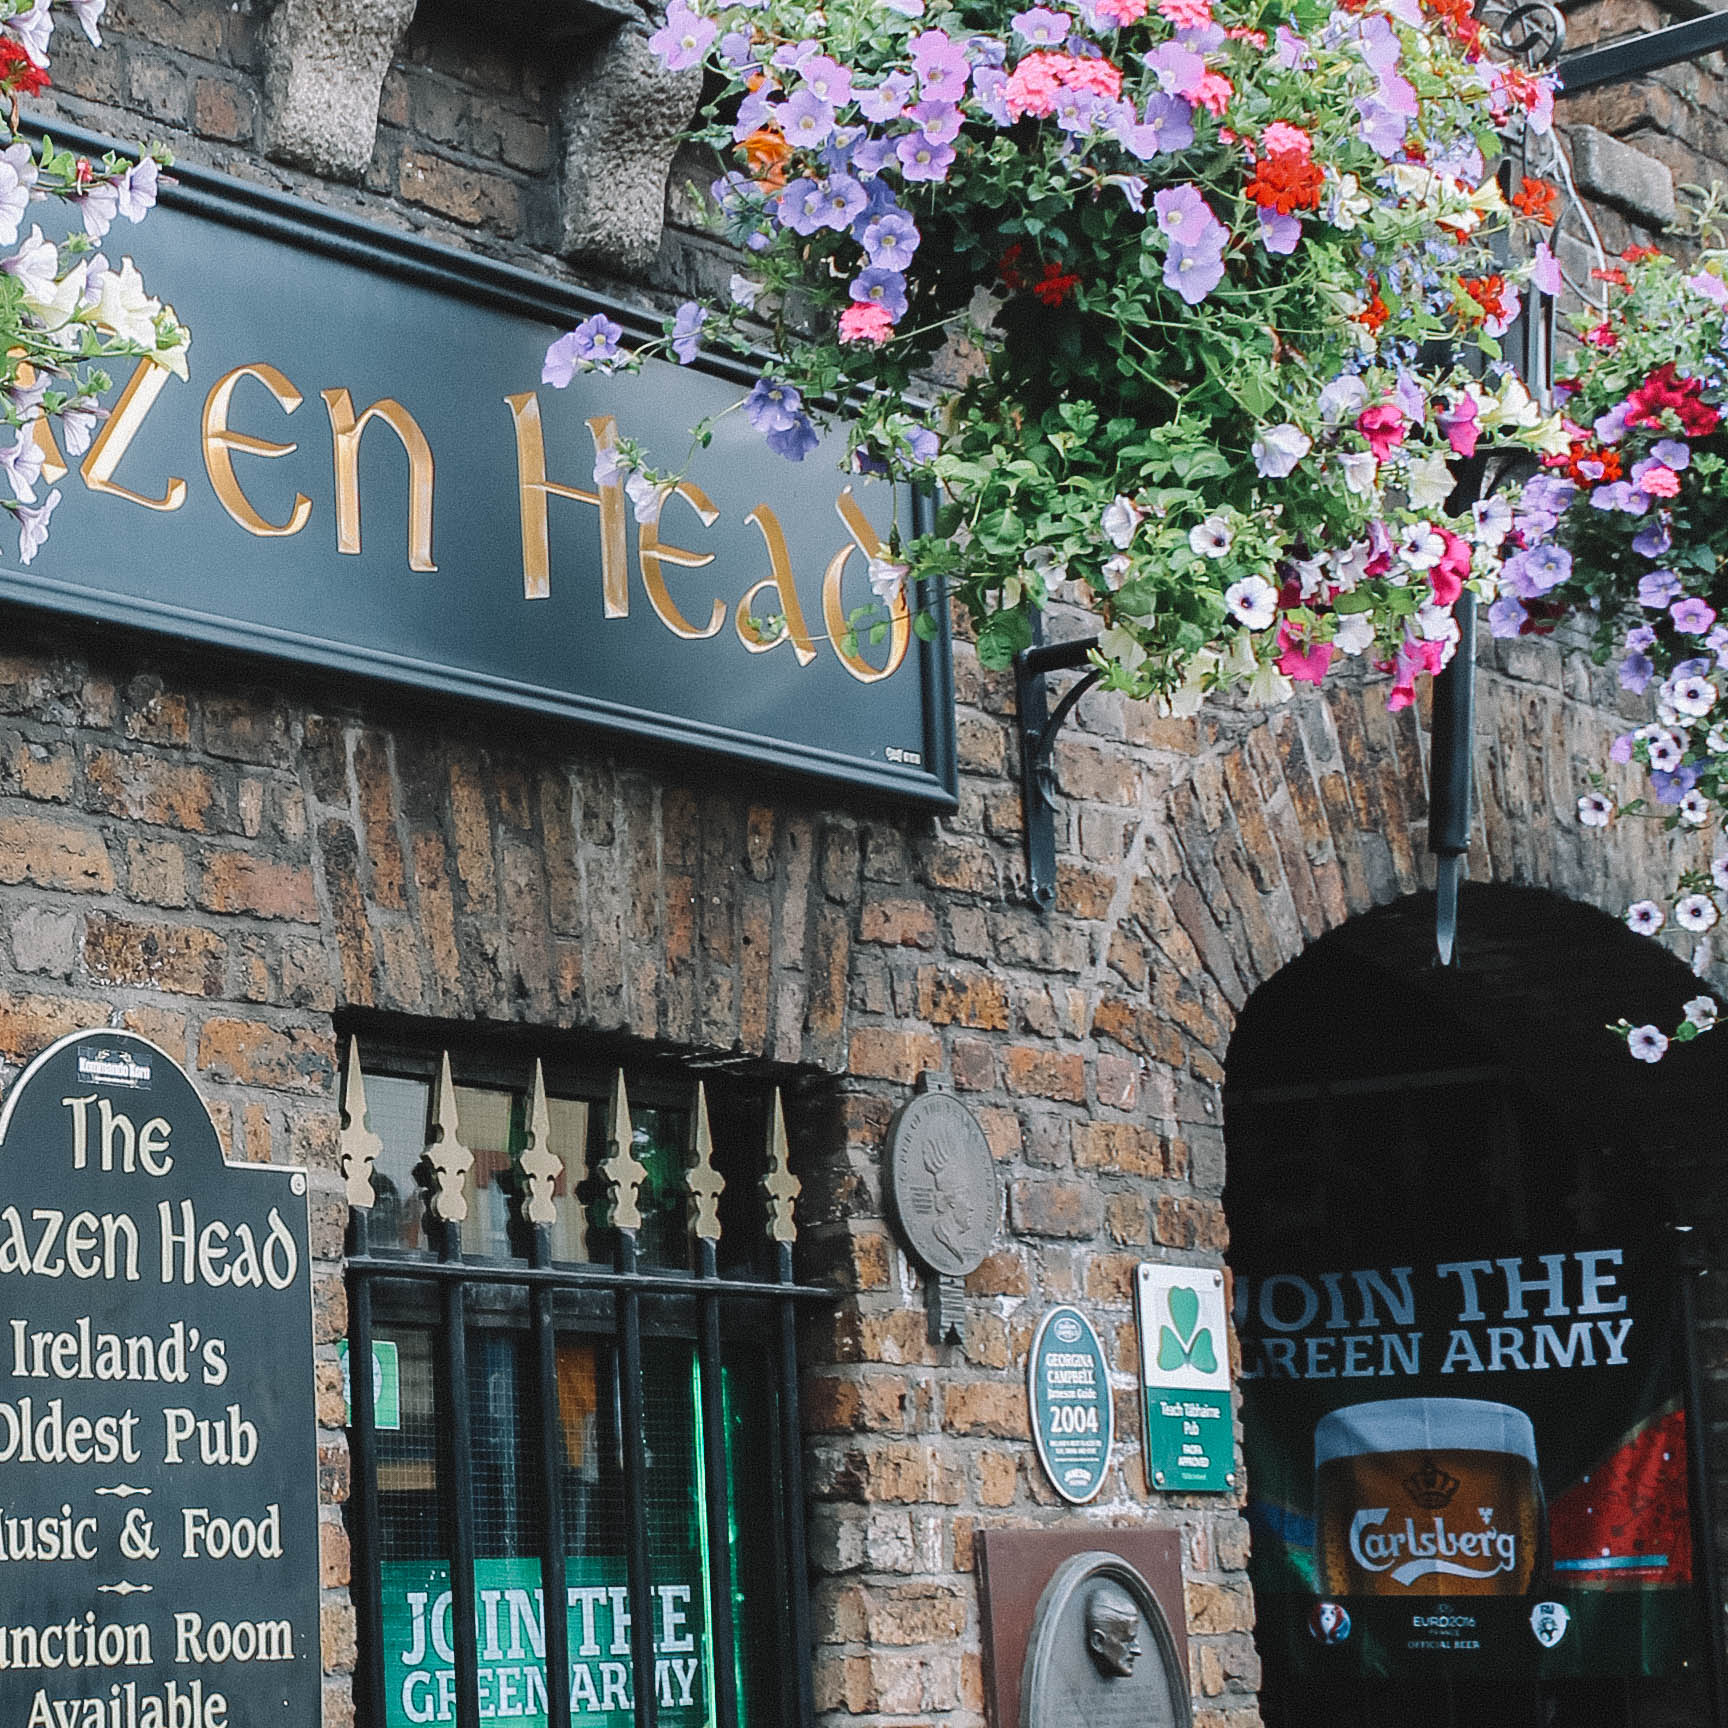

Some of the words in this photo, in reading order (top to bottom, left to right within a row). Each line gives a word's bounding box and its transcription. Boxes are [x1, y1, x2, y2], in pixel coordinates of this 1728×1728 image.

[61, 1094, 173, 1177] The
[1436, 1248, 1628, 1323] THE
[10, 1318, 229, 1386] Ireland's
[1440, 1318, 1633, 1374] ARMY
[164, 1404, 258, 1467] Pub
[1049, 1405, 1099, 1433] 2004
[118, 1512, 159, 1561] &
[181, 1505, 283, 1561] Food
[1349, 1507, 1516, 1573] Carlsberg
[174, 1610, 295, 1663] Room
[568, 1585, 694, 1657] THE
[401, 1666, 550, 1723] GREEN
[570, 1658, 698, 1713] ARMY
